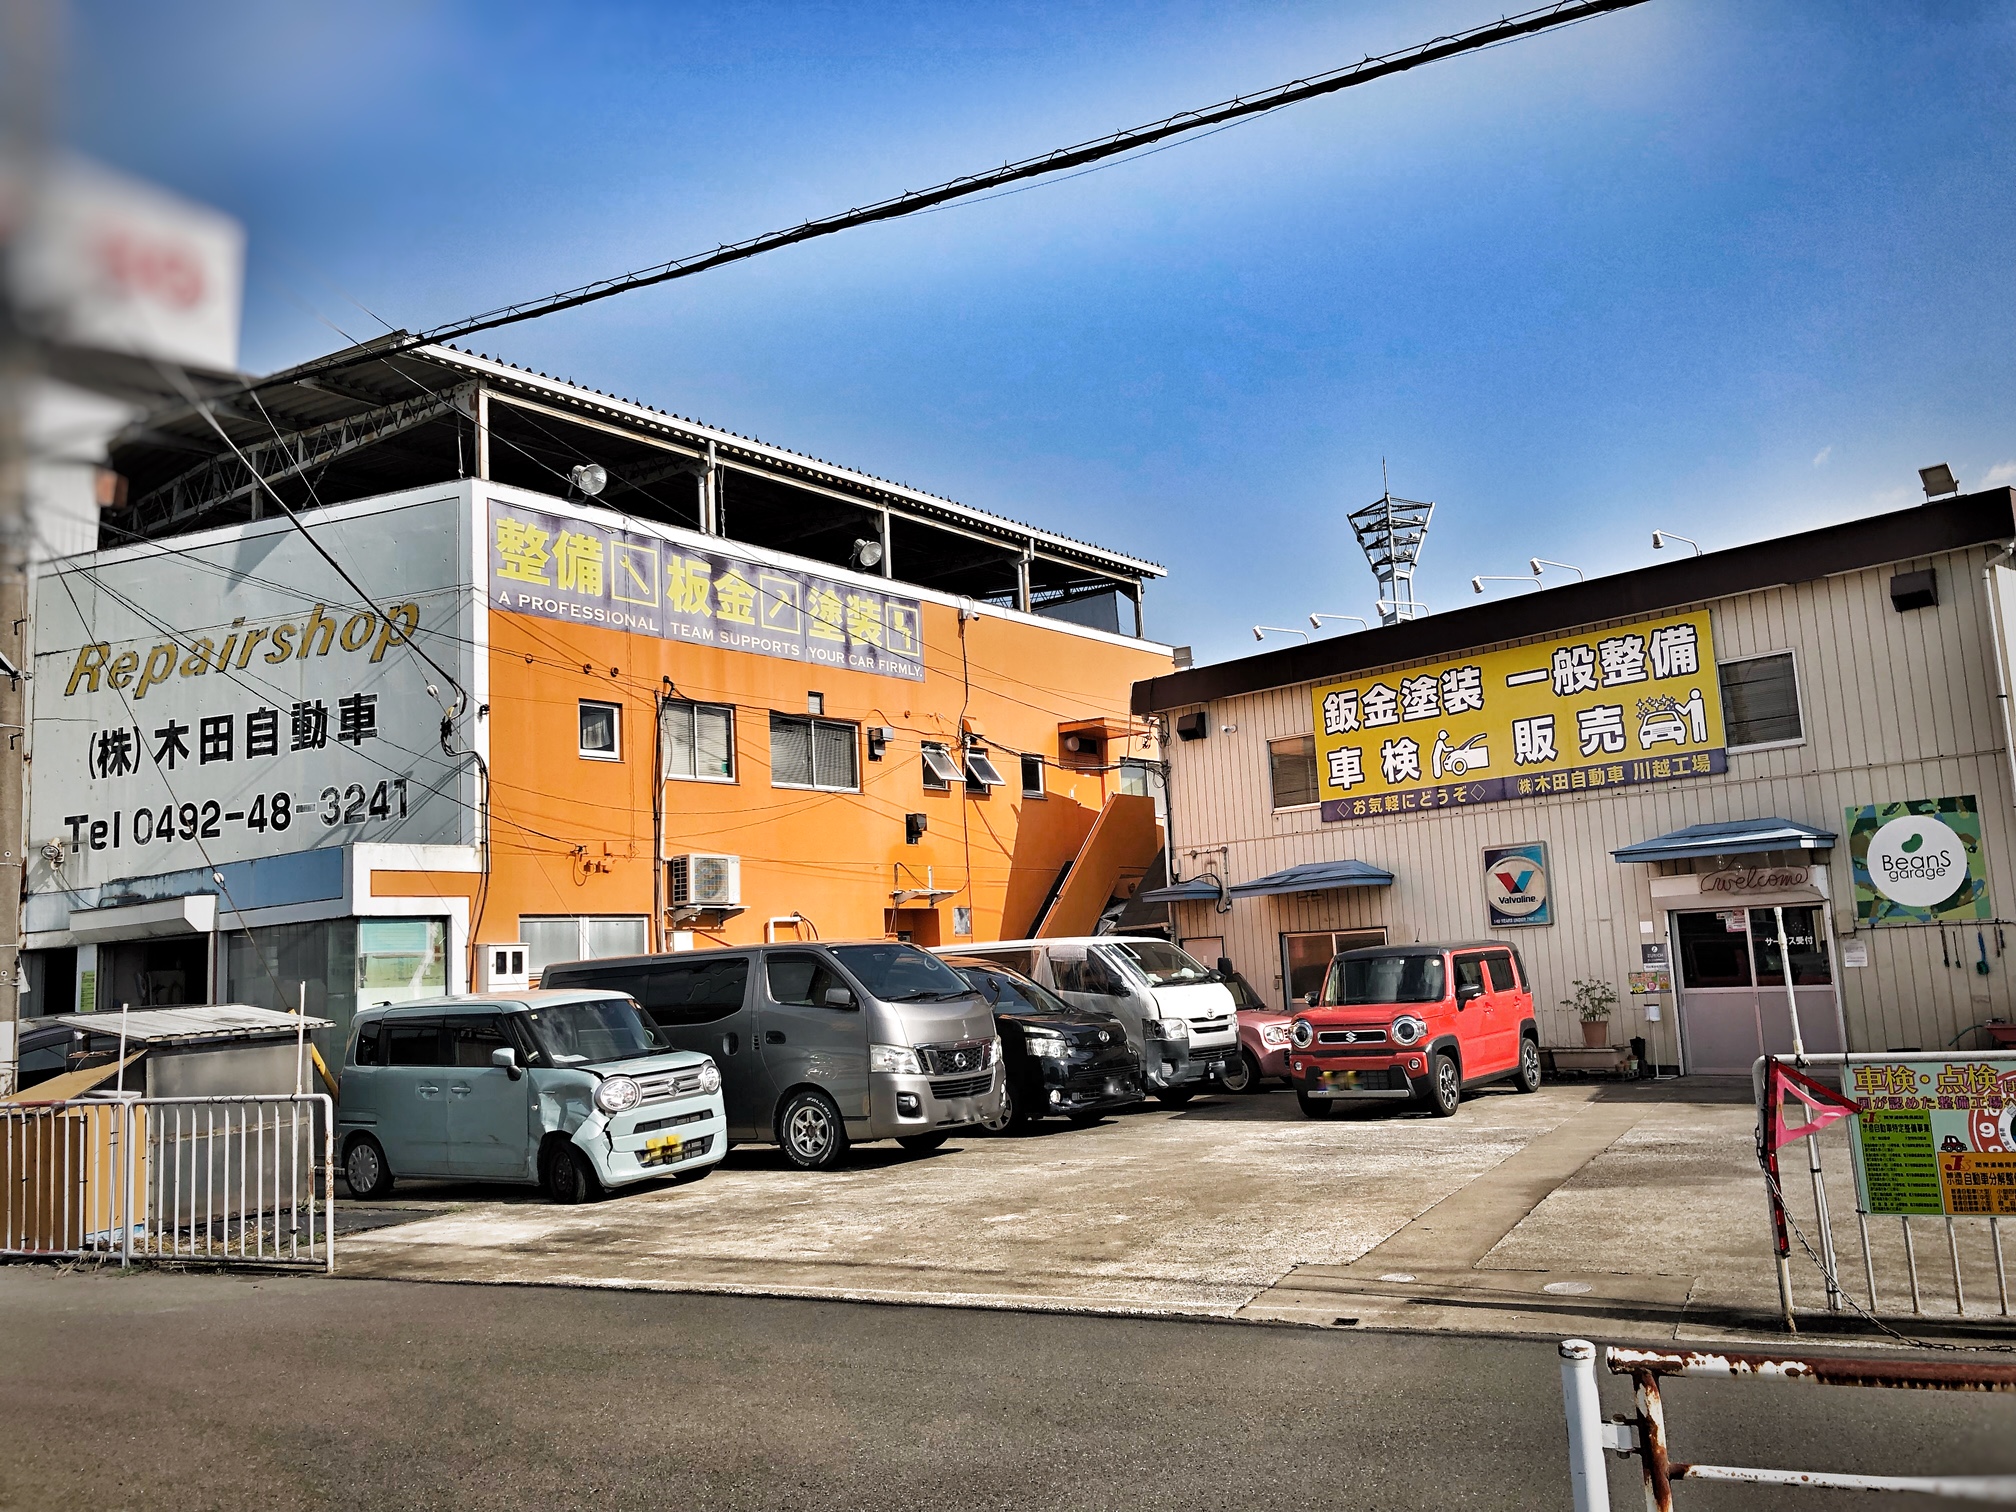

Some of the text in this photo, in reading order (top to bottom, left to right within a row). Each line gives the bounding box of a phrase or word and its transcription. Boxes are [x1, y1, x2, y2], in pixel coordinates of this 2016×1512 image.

[495, 517, 603, 597] 整備
[666, 555, 757, 626] 板金
[807, 586, 883, 647] 塗装
[64, 601, 420, 700] Repairshop
[498, 591, 923, 677] A PROFESSIONAL TEAM SUPPORTS YOUR CAR FIRMLY.
[1324, 624, 1699, 736] 鈑金塗装 一般整備
[1328, 704, 1626, 790] 車検 販売
[64, 777, 409, 853] Tel 0492-48-3241
[1353, 785, 1467, 815] お気軽にどうぞ
[1633, 754, 1711, 780] 川越工場
[1498, 895, 1536, 904] Valvoline
[1701, 862, 1808, 892] welcome
[1889, 867, 1946, 882] garage
[1765, 936, 1813, 946] サース受付
[1979, 1122, 1995, 1138] 9
